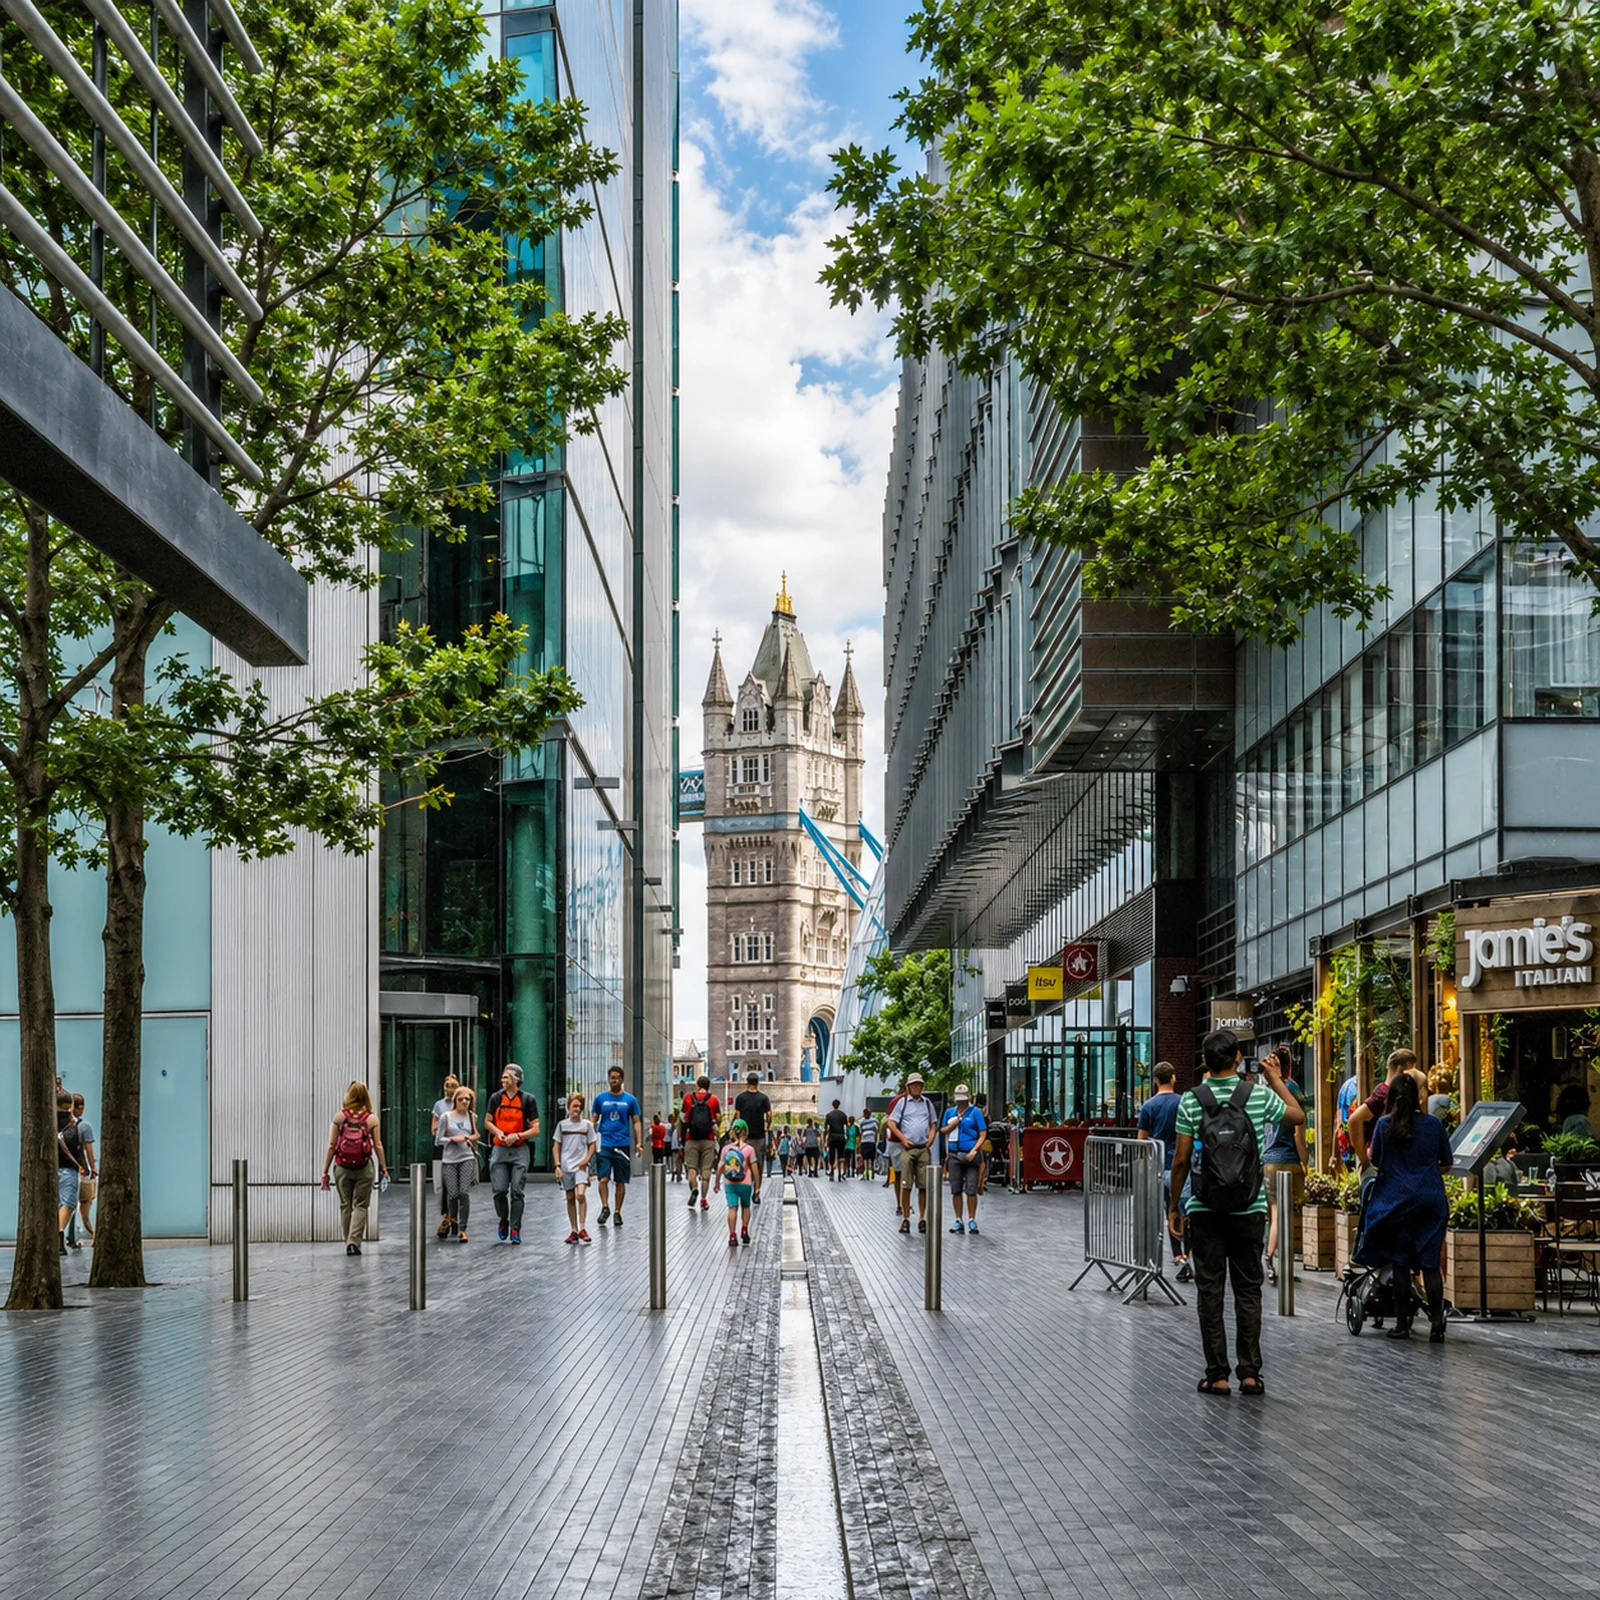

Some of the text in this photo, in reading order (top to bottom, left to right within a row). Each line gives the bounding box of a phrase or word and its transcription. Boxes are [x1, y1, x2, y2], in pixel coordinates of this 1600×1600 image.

[1035, 976, 1057, 987] itsu
[1515, 966, 1592, 987] ITALIAN
[1008, 995, 1027, 1007] pod
